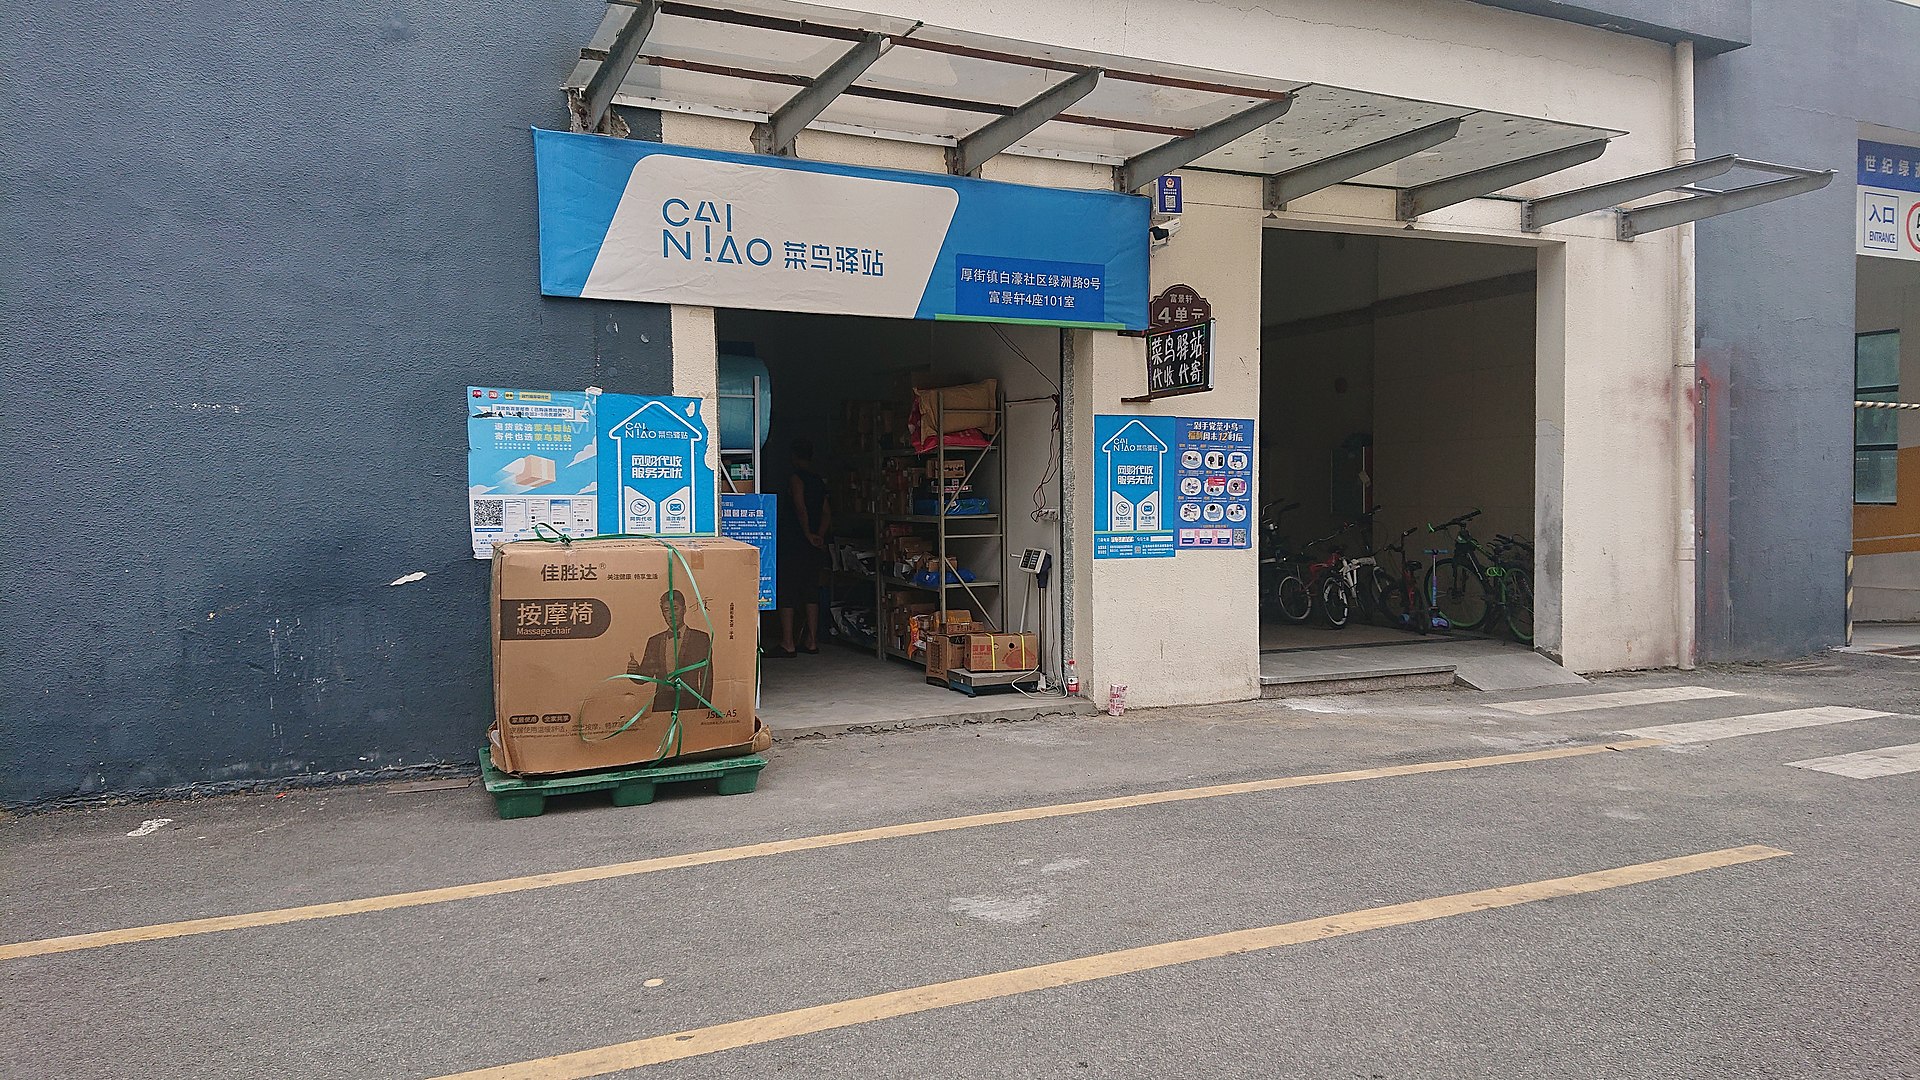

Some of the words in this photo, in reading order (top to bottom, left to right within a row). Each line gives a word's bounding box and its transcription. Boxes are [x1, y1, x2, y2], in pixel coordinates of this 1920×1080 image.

[662, 198, 732, 233] CAI
[1868, 204, 1895, 225] 入口
[1869, 230, 1896, 244] ENTRANCE
[783, 240, 884, 277] 菜鸟驿站
[960, 267, 1101, 291] 厚街镇白濠社区绿洲路9号
[988, 290, 1075, 308] 富景轩4座101室
[1170, 293, 1193, 304] 富景轩
[1158, 306, 1204, 324] 4单元
[1151, 330, 1203, 365] 菜鸟驿站
[1152, 365, 1175, 389] 代收
[1178, 359, 1202, 385] 代寄
[631, 455, 683, 467] 网购代收
[1117, 465, 1154, 475] 网购代收
[631, 467, 683, 479] 服务无忧
[1117, 475, 1154, 485] 服务无忧
[517, 602, 594, 626] 按摩椅
[517, 627, 550, 637] Massage
[551, 626, 571, 635] chair
